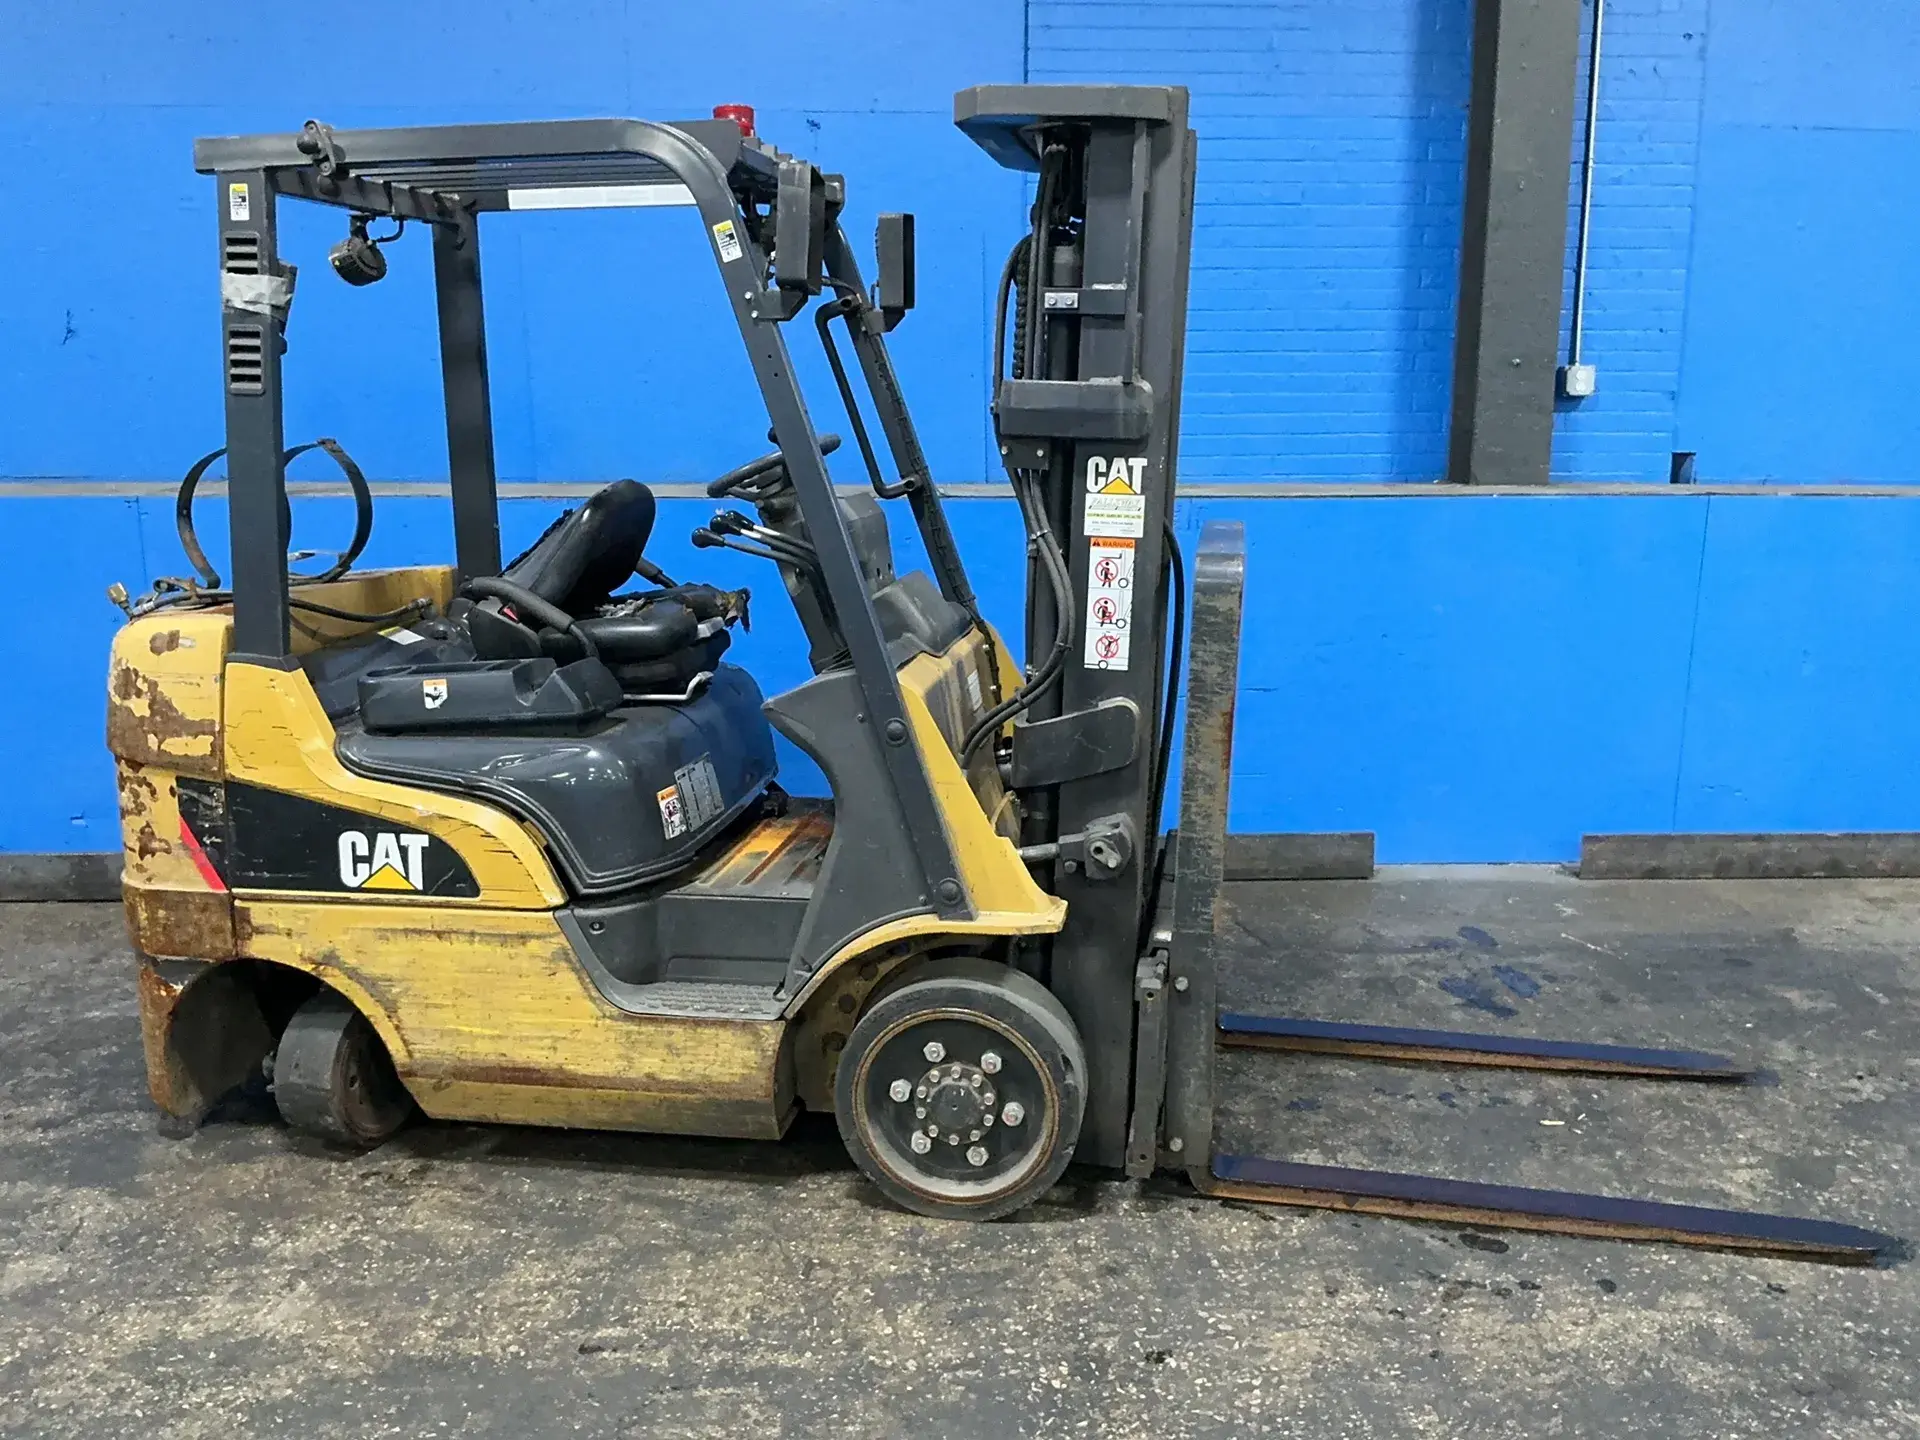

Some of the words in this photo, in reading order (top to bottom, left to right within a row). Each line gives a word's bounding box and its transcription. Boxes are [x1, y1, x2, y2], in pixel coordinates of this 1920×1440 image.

[1086, 456, 1148, 494] CAT
[1102, 540, 1134, 549] WARNING
[338, 830, 429, 891] CAT
